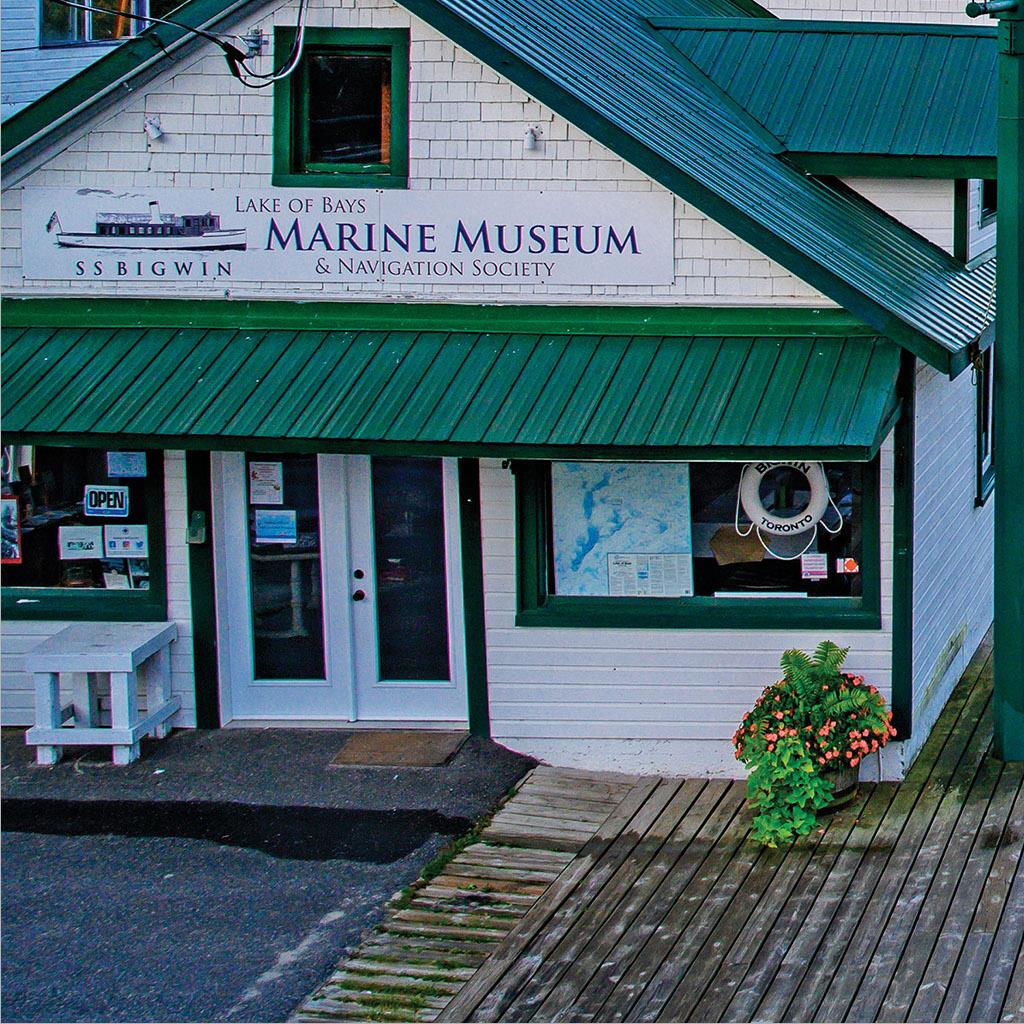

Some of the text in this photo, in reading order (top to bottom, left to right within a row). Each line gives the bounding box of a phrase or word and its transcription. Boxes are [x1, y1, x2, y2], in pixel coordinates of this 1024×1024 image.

[235, 196, 366, 214] LAKE OF BAYS
[264, 217, 642, 255] MARINE MUSEUM
[116, 261, 232, 277] BIGWIN
[315, 257, 555, 277] & NAVIGATION SOCIETY
[89, 490, 125, 509] OPEN
[761, 514, 813, 533] TORONTO
